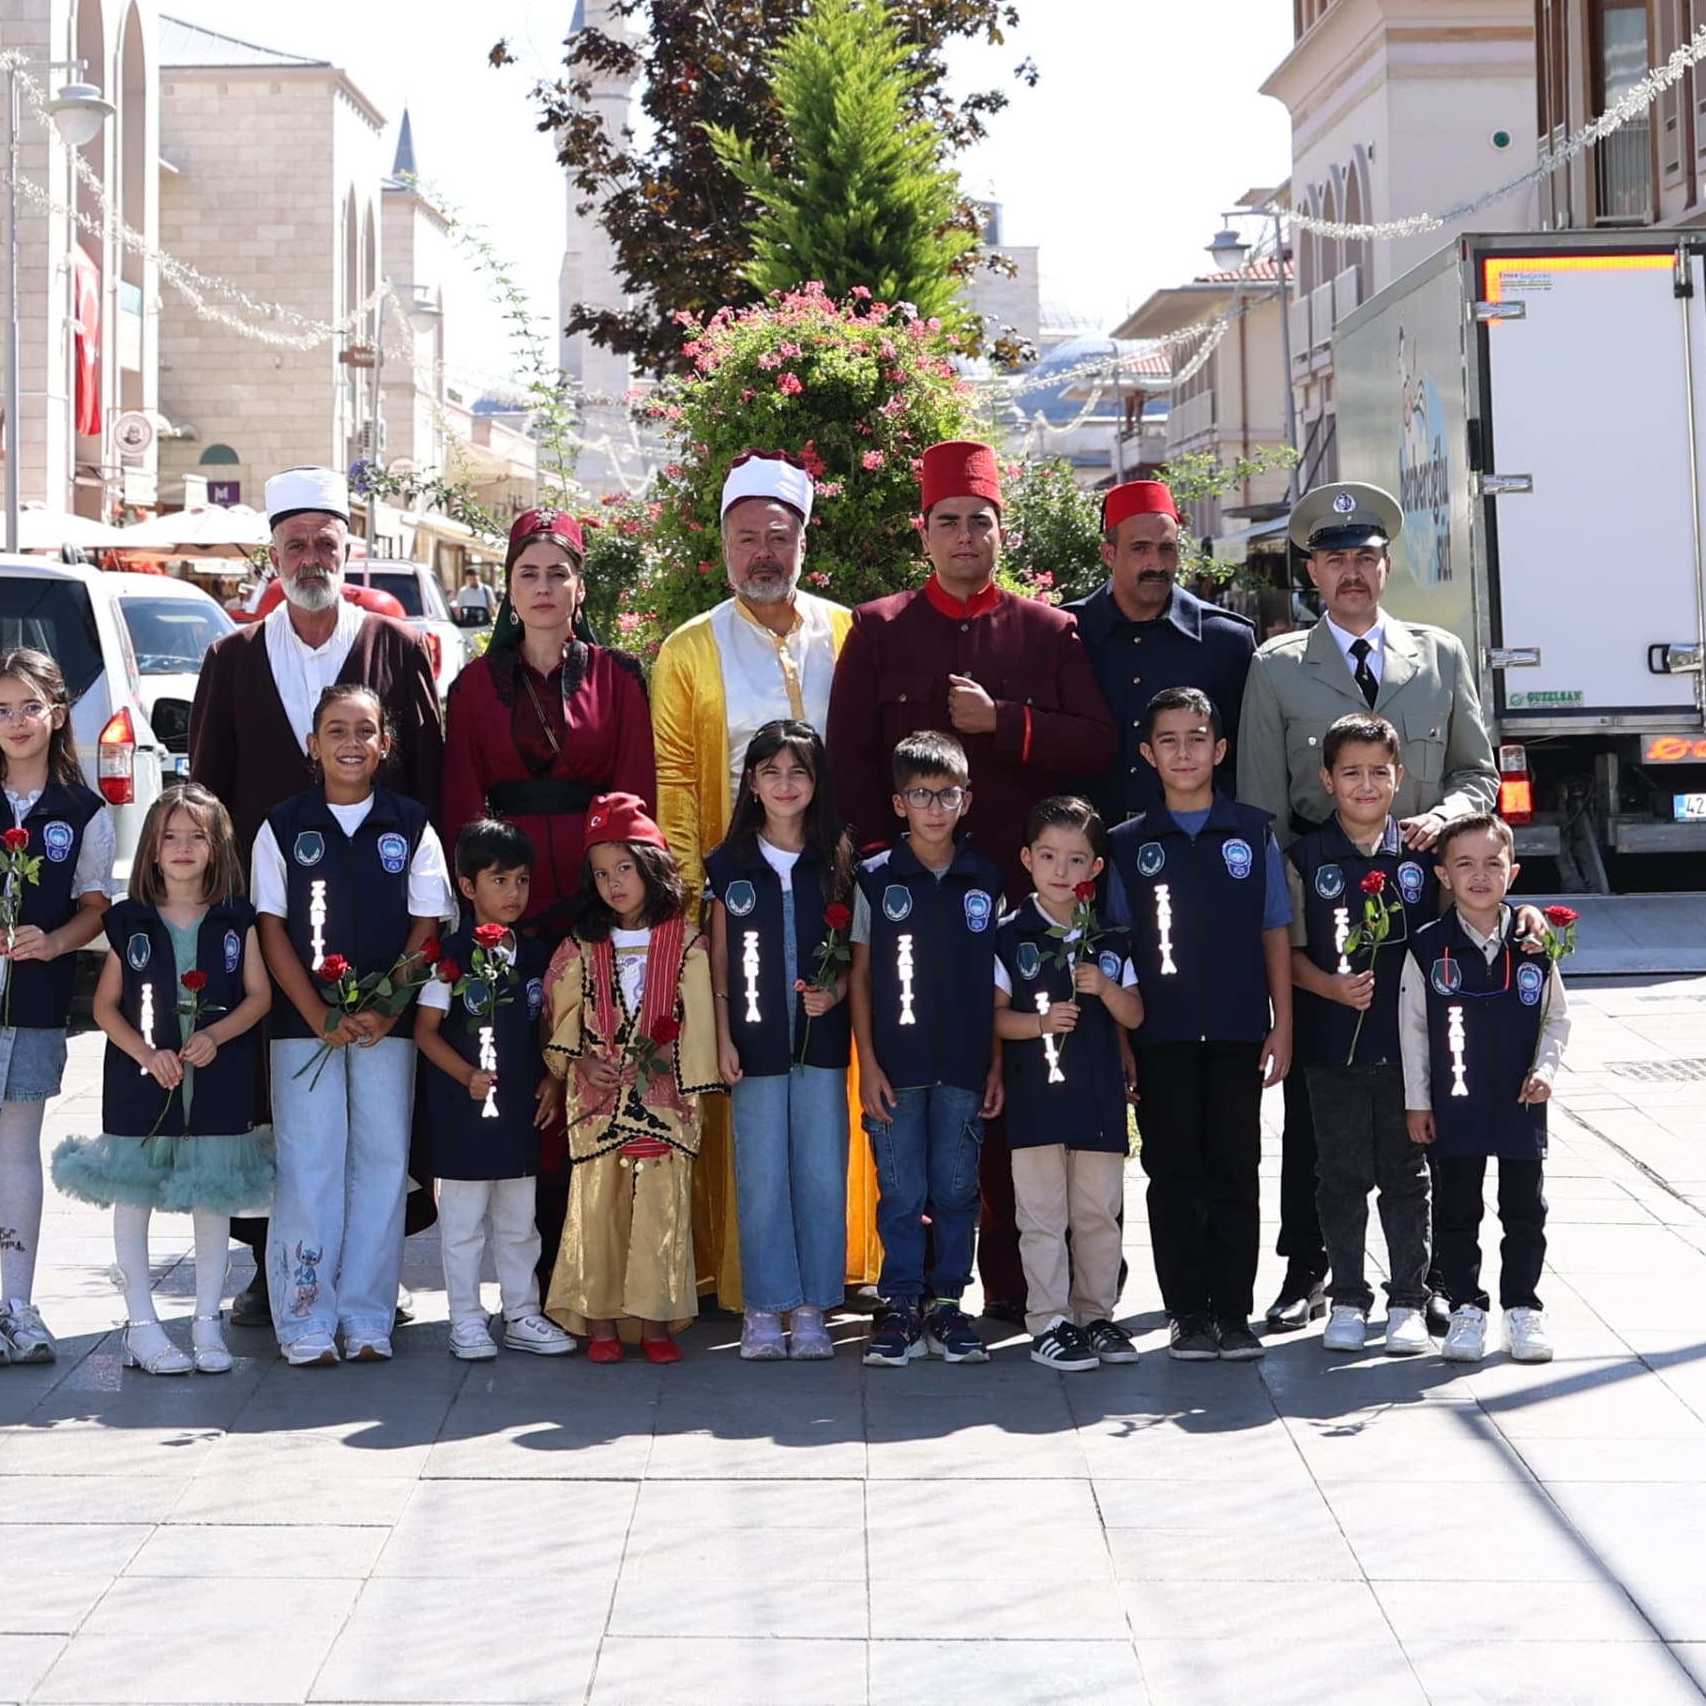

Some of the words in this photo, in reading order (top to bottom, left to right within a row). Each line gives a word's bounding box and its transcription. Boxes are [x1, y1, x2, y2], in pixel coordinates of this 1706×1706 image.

[1685, 796, 1706, 816] 42
[1153, 883, 1179, 976] ZABITA
[742, 930, 762, 1023] ZABITA
[897, 933, 916, 1026] ZABITA
[1447, 1005, 1470, 1097] ZABITA
